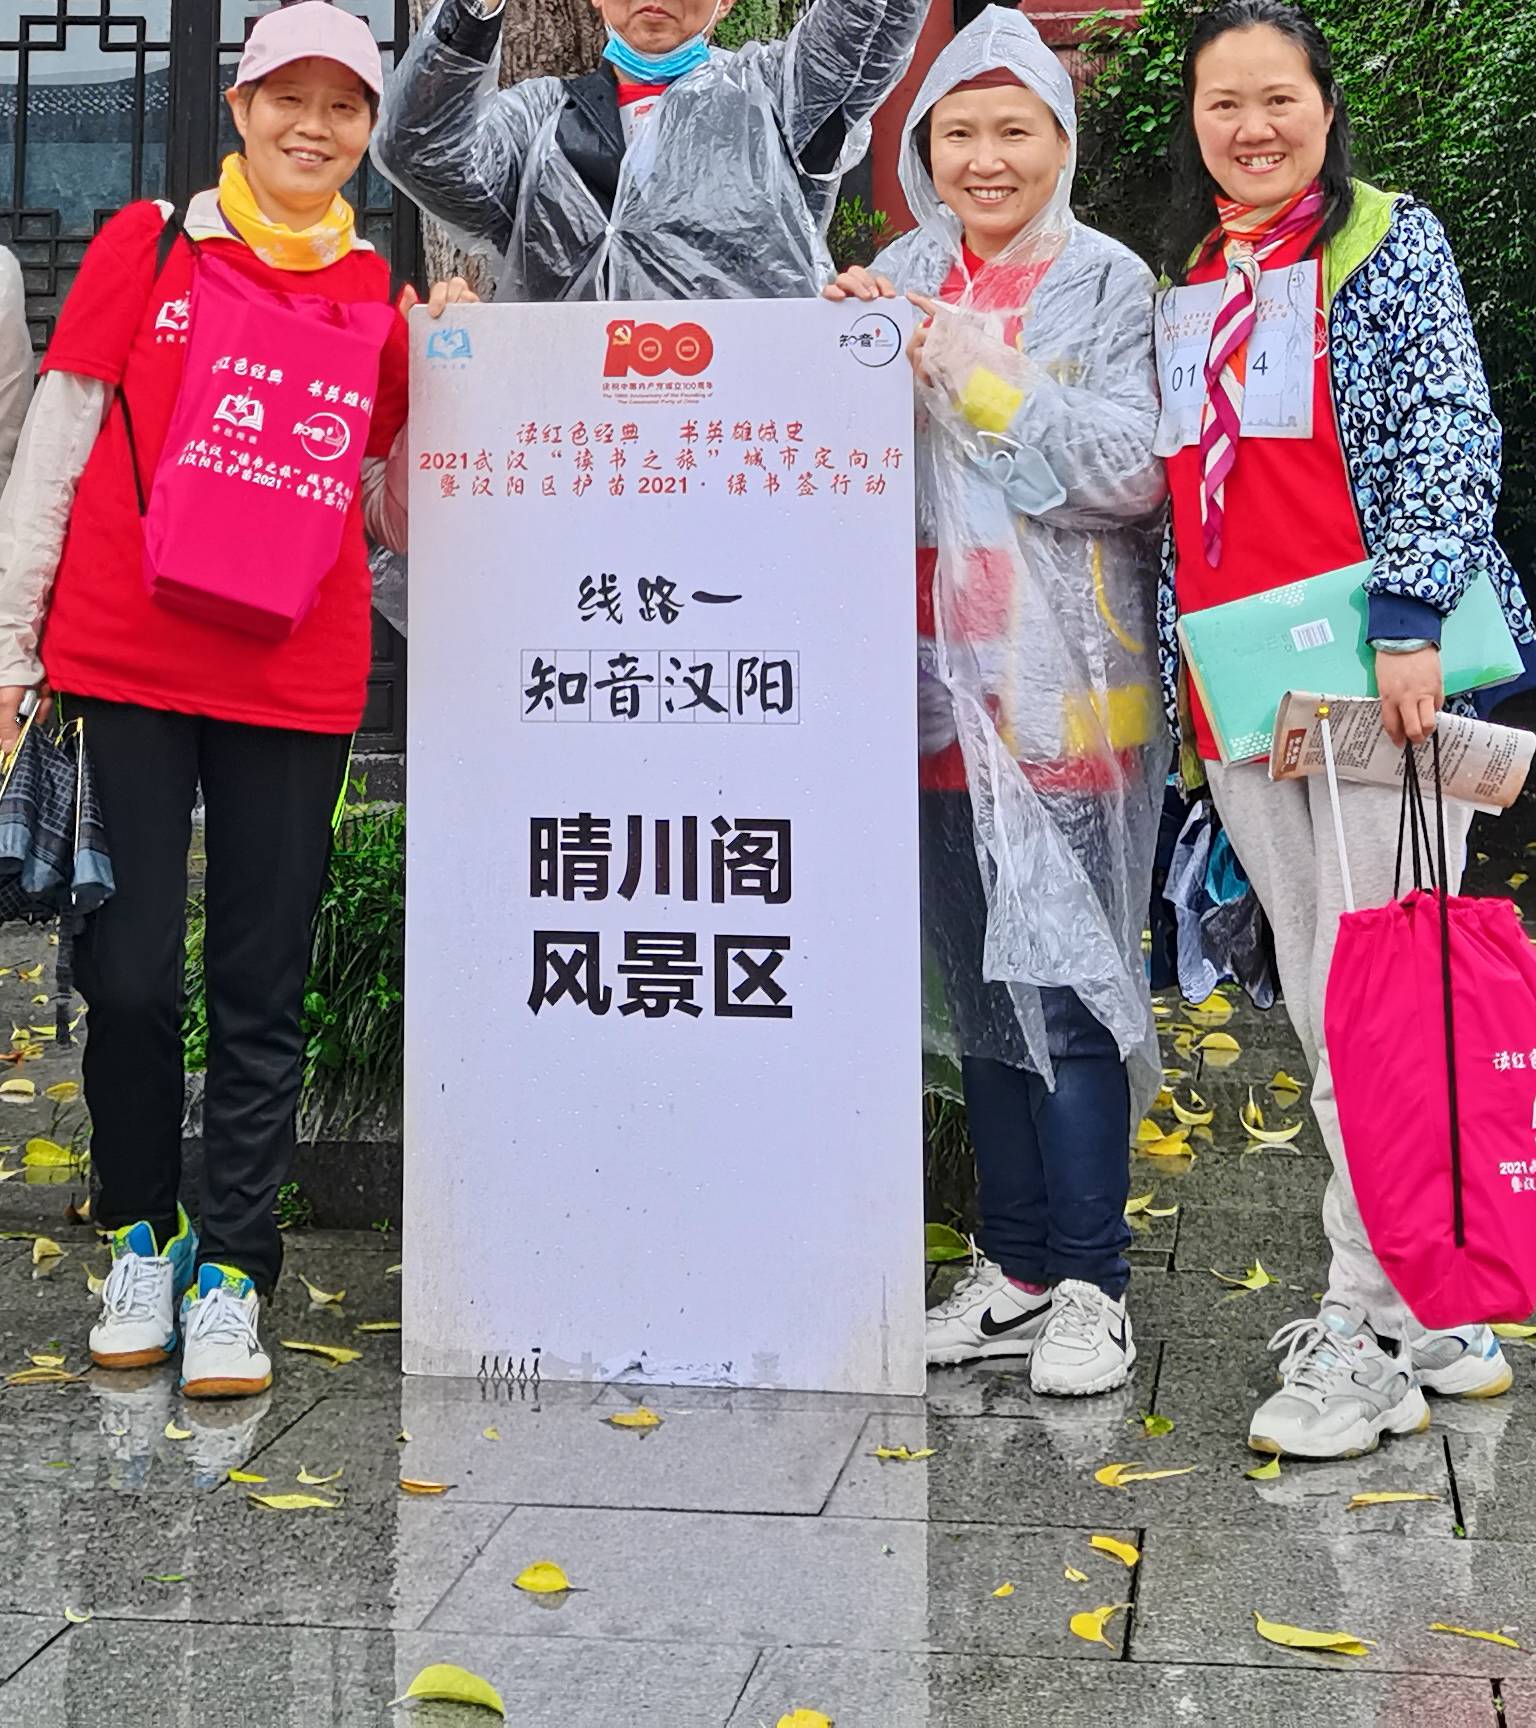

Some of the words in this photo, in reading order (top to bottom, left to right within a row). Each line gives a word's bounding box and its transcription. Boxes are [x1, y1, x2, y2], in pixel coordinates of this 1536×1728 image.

[516, 421, 639, 446] 读红色经典
[679, 419, 805, 447] 书英雄城史
[577, 573, 743, 625] 线路一
[524, 652, 795, 720] 知音汉阳
[529, 812, 793, 905] 晴川阁
[527, 929, 793, 1019] 风景区
